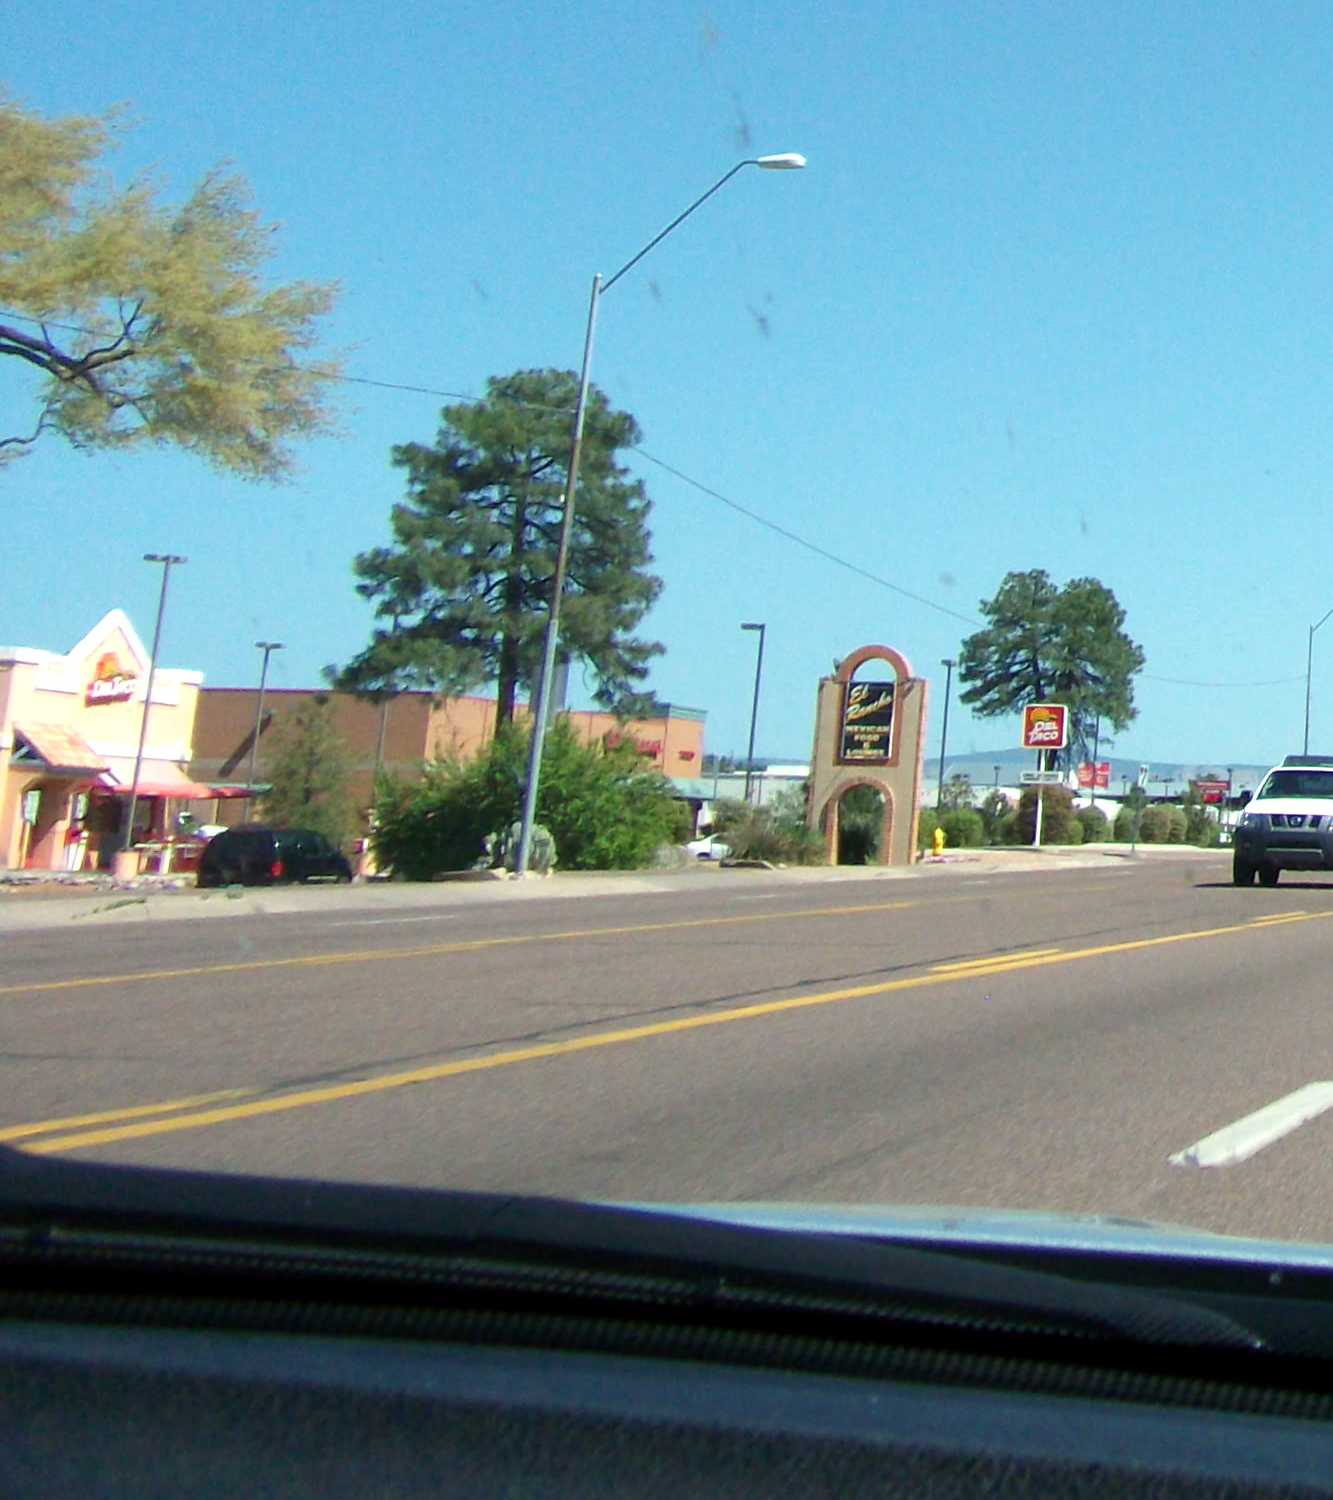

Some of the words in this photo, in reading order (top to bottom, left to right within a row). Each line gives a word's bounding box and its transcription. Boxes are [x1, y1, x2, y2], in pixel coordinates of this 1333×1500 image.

[848, 683, 870, 706] El
[846, 690, 893, 722] Rancho
[845, 724, 890, 733] MEXICAN
[1033, 721, 1059, 731] DEL
[853, 733, 881, 742] FOOD
[1027, 730, 1060, 745] TACO
